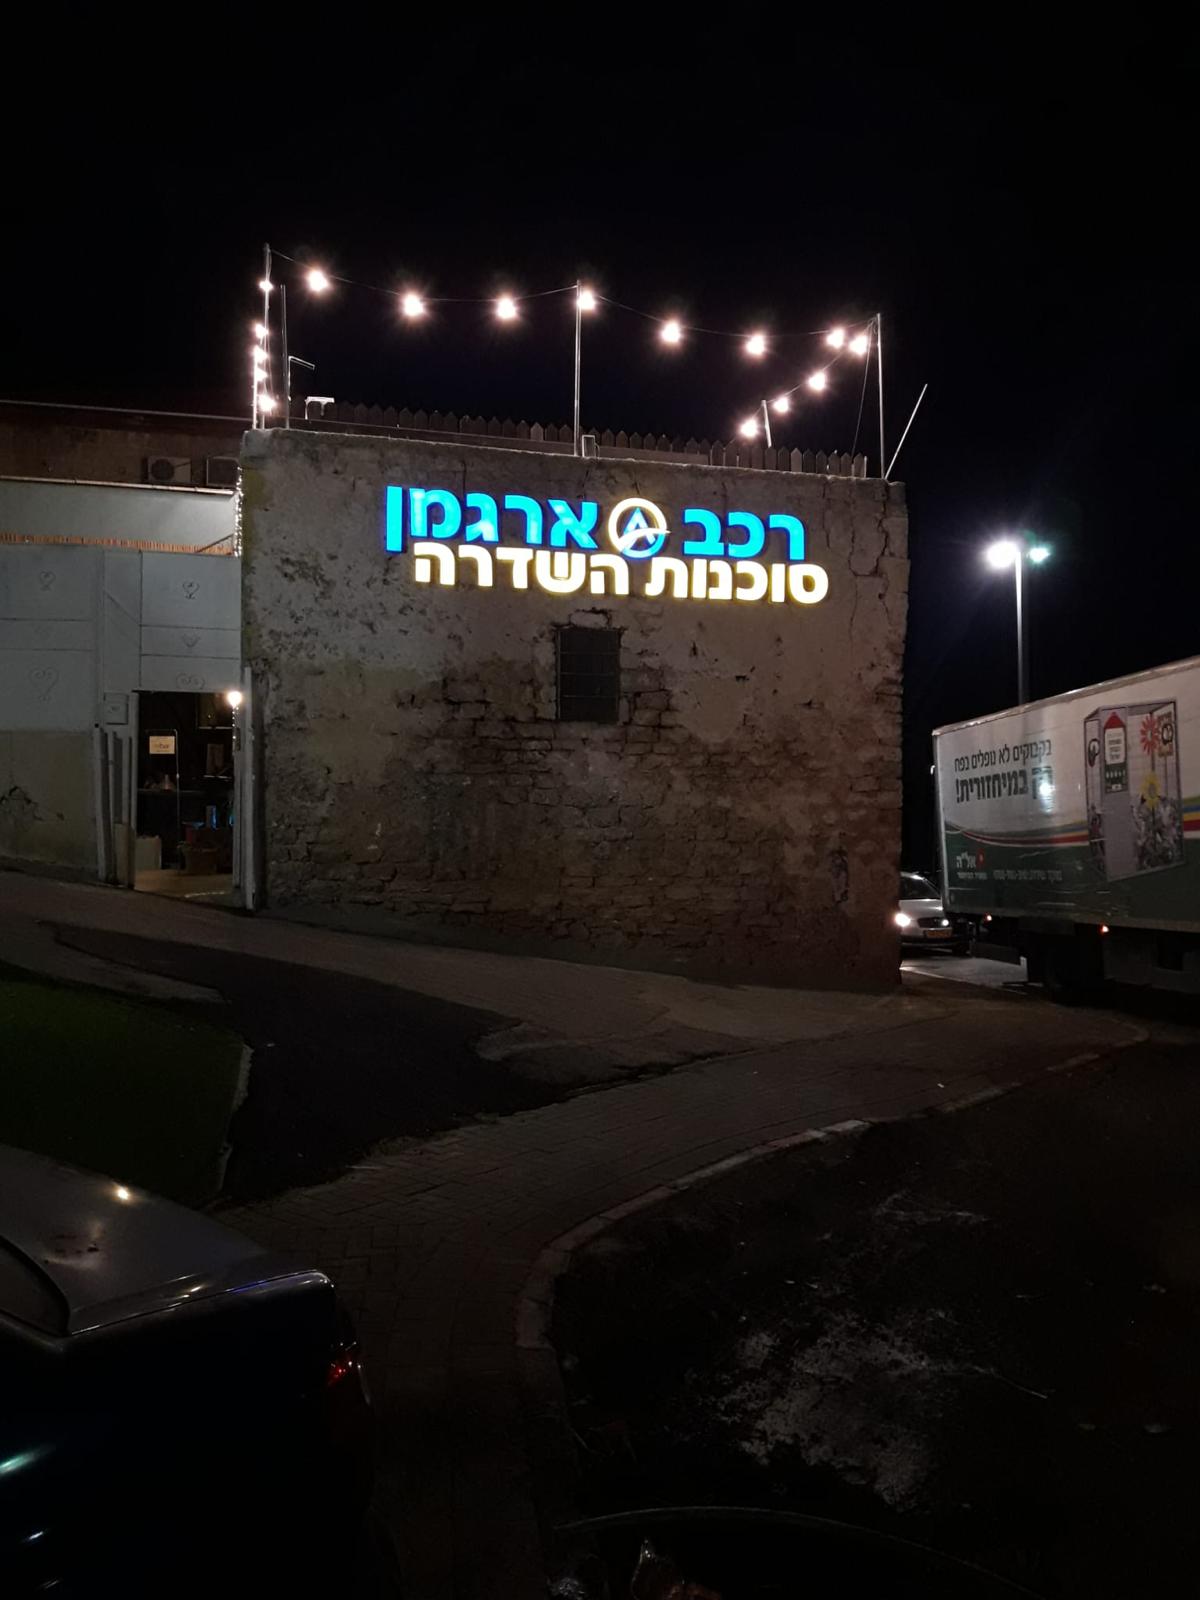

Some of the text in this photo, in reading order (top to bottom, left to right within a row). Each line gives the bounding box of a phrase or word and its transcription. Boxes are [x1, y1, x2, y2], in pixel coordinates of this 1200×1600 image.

[386, 485, 805, 561] רכב ארגמן
[413, 541, 829, 604] סוכנות השדרה
[971, 749, 996, 770] נופלים
[999, 743, 1010, 765] לא
